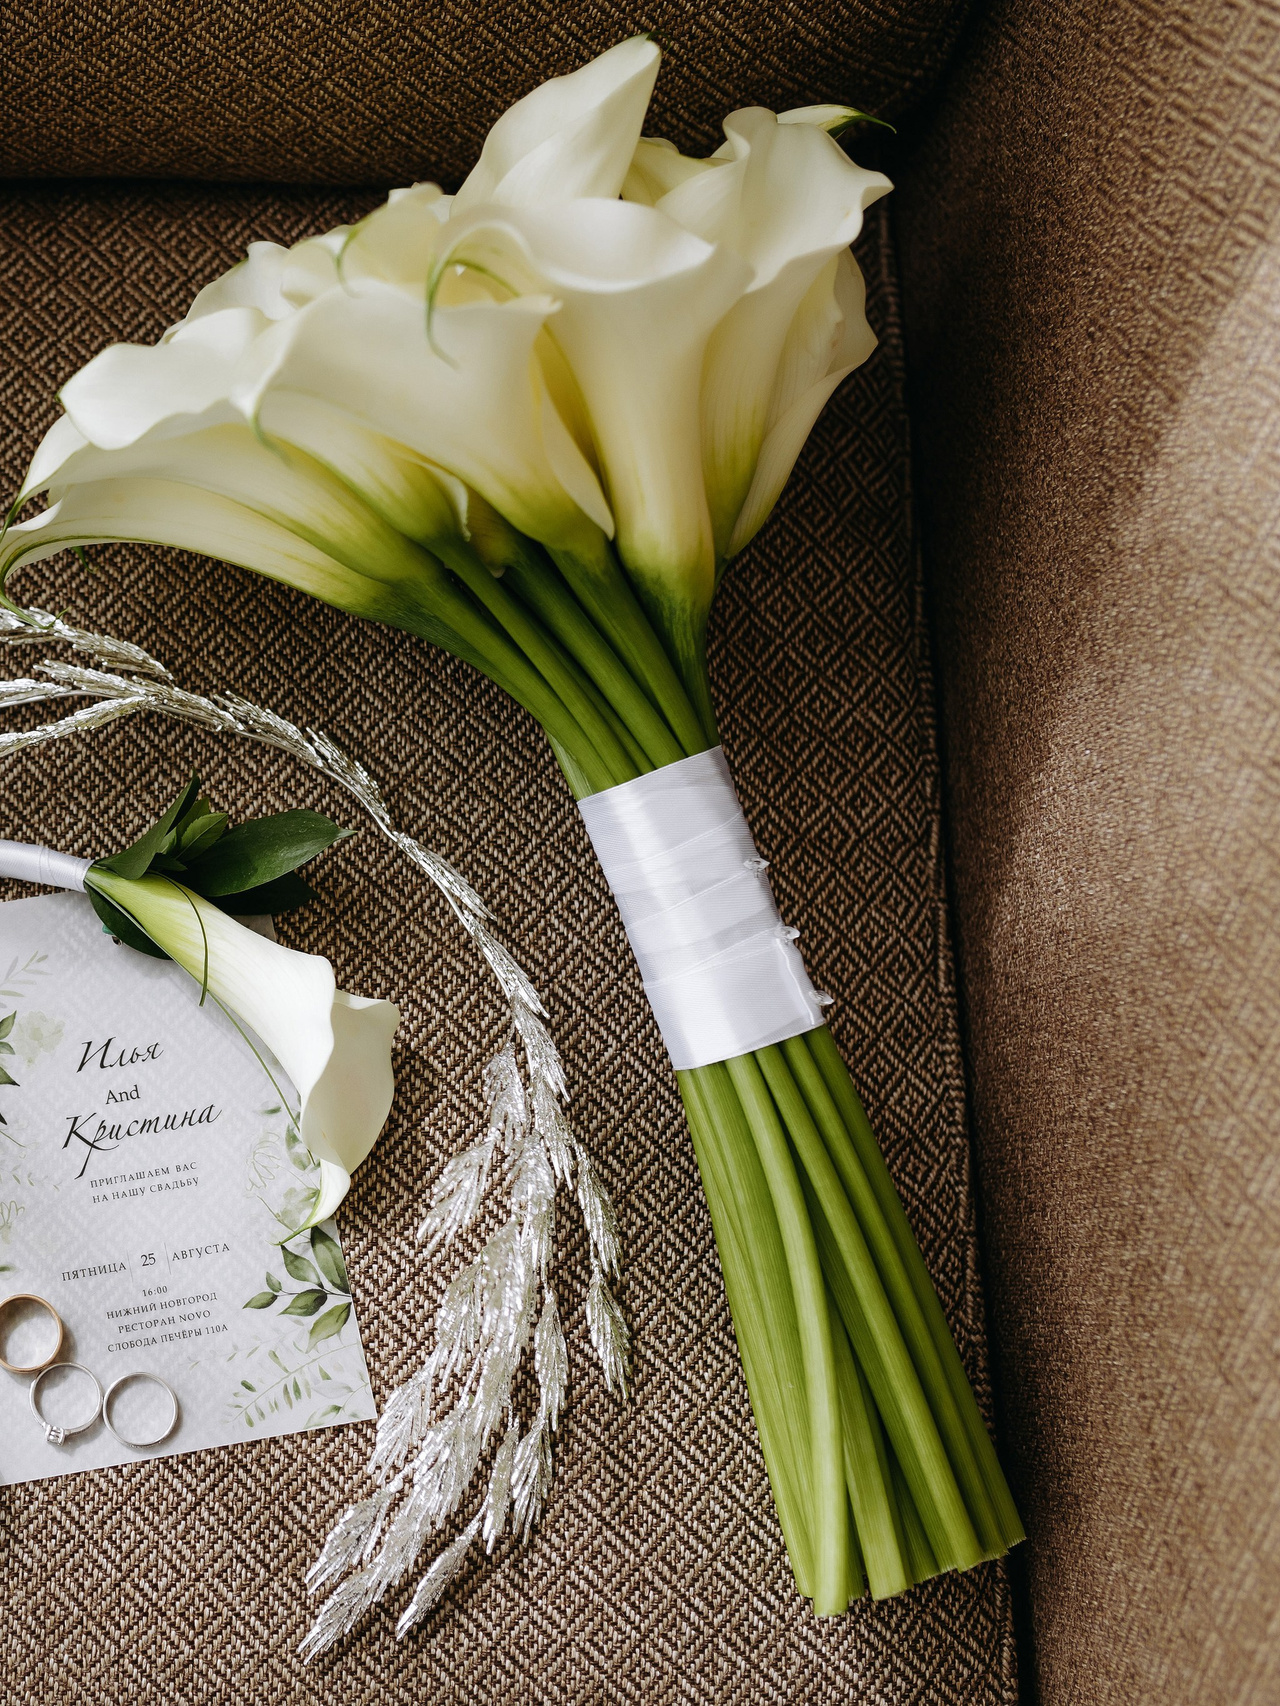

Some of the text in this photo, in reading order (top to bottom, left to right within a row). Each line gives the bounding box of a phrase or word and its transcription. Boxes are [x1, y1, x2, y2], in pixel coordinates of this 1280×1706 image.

[76, 1036, 164, 1073] Илья
[105, 1084, 141, 1105] And
[62, 1104, 222, 1180] Кристина
[90, 1161, 198, 1188] ПРИГЛАШАЕМ ВАС
[92, 1177, 199, 1203] НА НАШУ СВАДЬБУ
[61, 1243, 230, 1281] ПЯТНИЦА 25 АВГУСТА
[142, 1285, 168, 1297] 16:00
[106, 1292, 218, 1319] НИЖНИЙ НОВГОРОД
[118, 1309, 211, 1333] РЕСТОРАН NOVO
[107, 1337, 157, 1353] СЛОБОДА
[160, 1328, 202, 1343] ПЕЧЁРЫ
